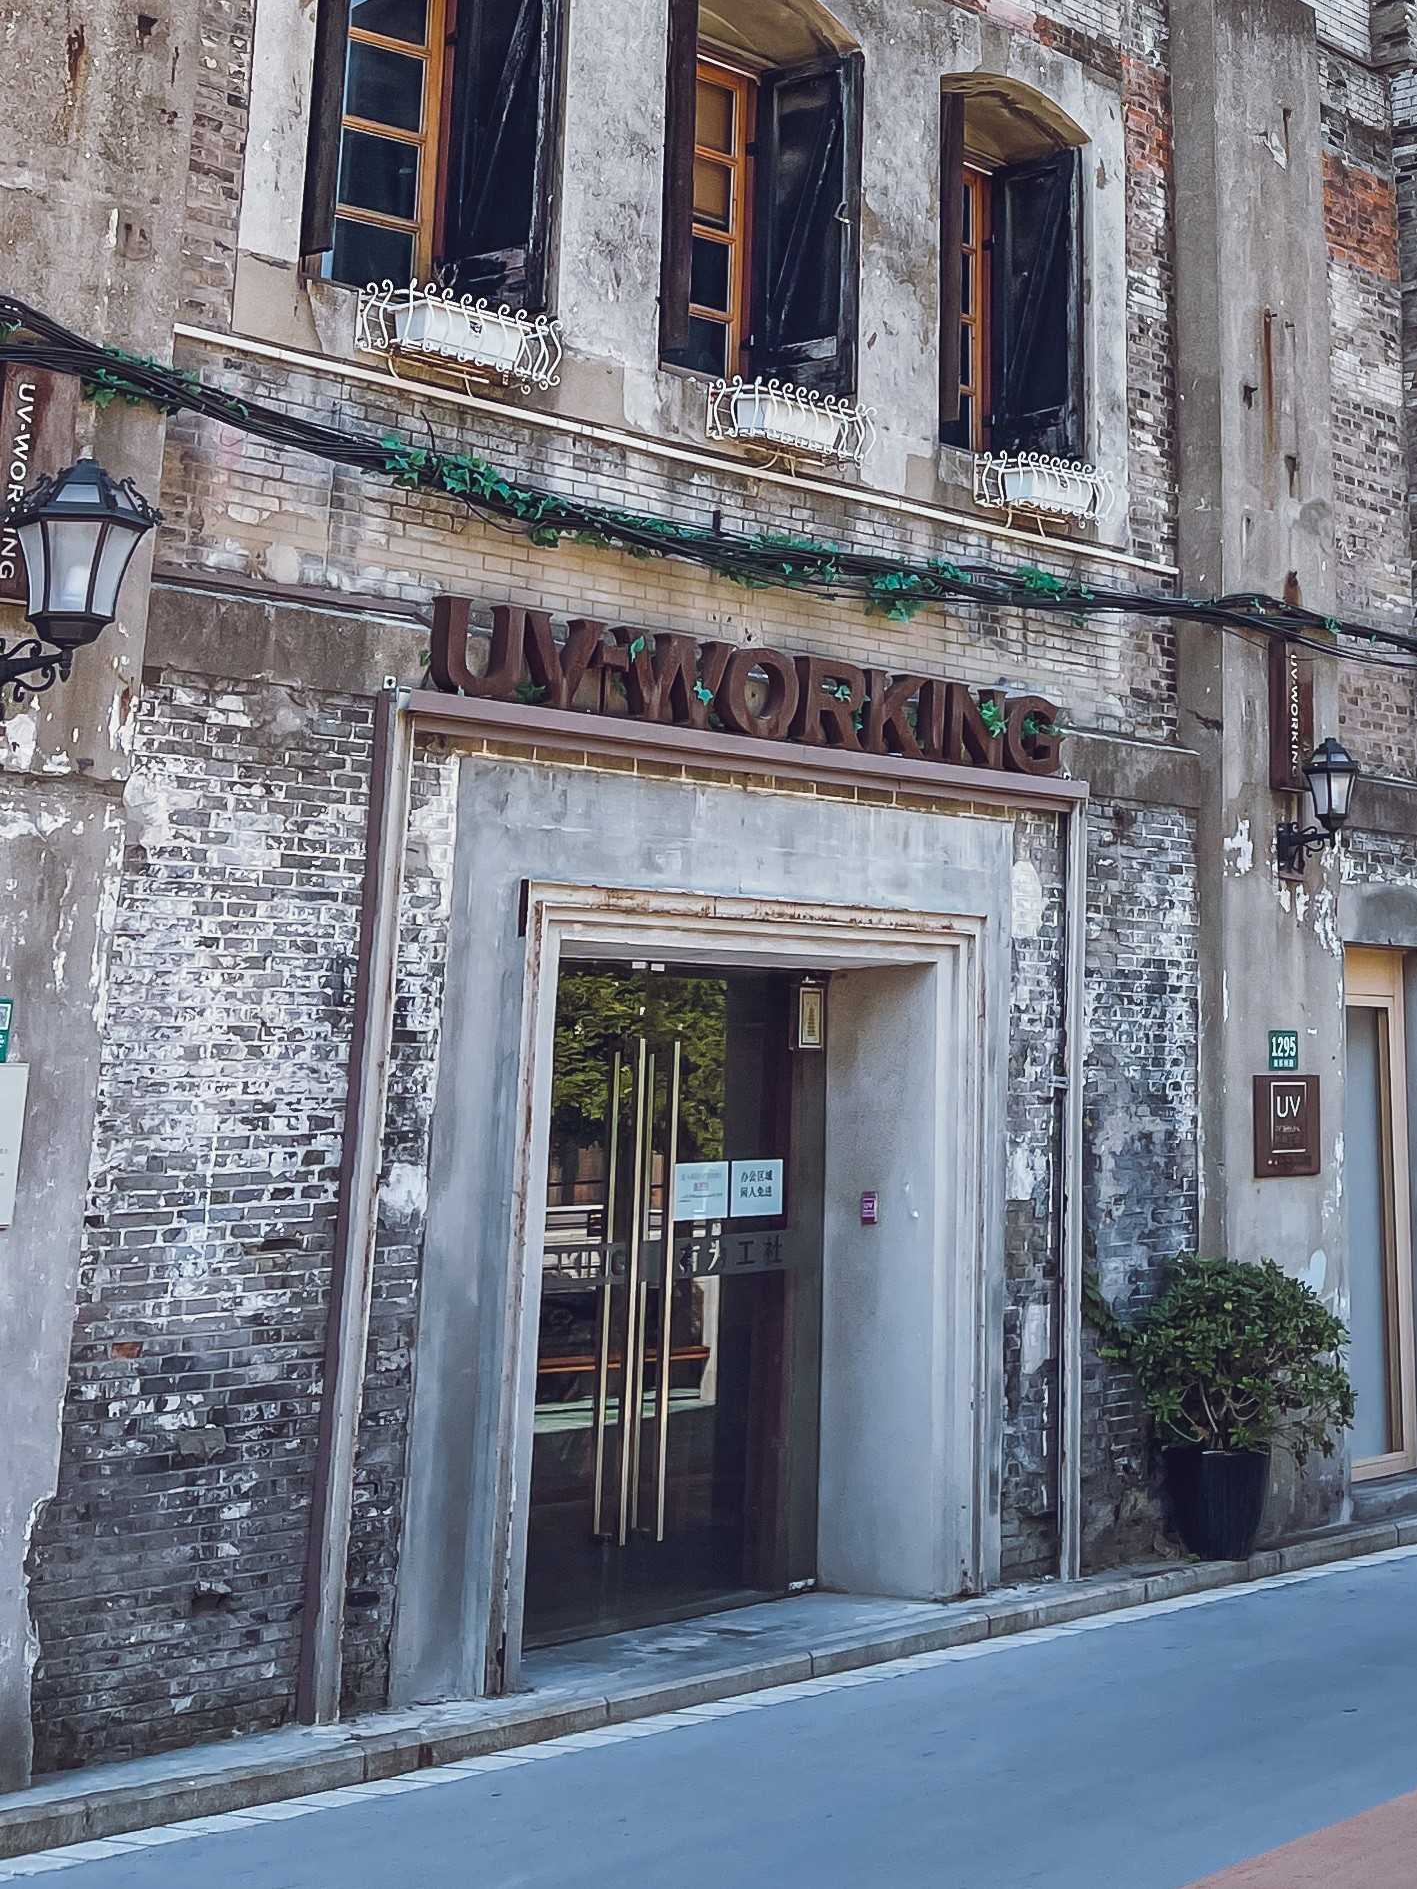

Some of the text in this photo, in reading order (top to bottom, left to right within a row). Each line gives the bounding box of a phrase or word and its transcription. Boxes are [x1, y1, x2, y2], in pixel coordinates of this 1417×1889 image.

[0, 382, 36, 580] UV-WORING
[430, 595, 1067, 775] UV-WORKING
[1271, 1036, 1297, 1058] 1295
[1276, 1096, 1301, 1118] UV
